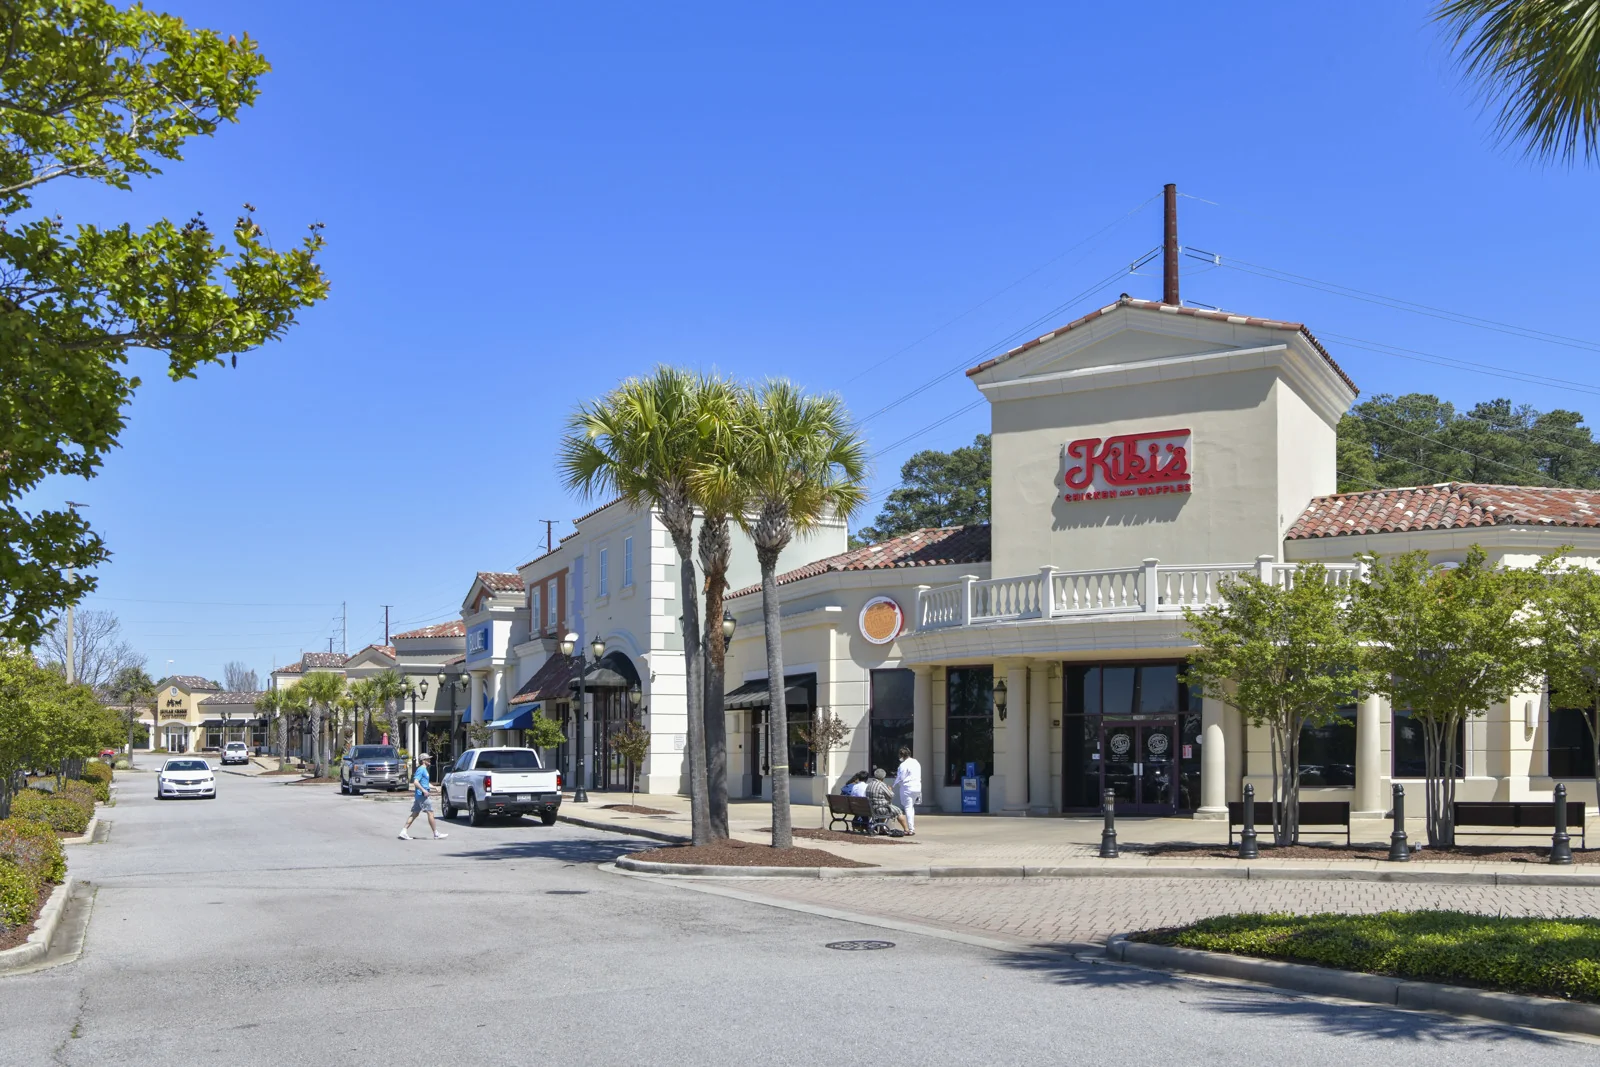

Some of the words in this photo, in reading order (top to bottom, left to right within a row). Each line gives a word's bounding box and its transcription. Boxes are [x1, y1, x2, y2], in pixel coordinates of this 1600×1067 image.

[1065, 429, 1191, 489] Kiki's
[1064, 490, 1118, 502] CHICKEN
[1137, 484, 1191, 496] WAFFLES
